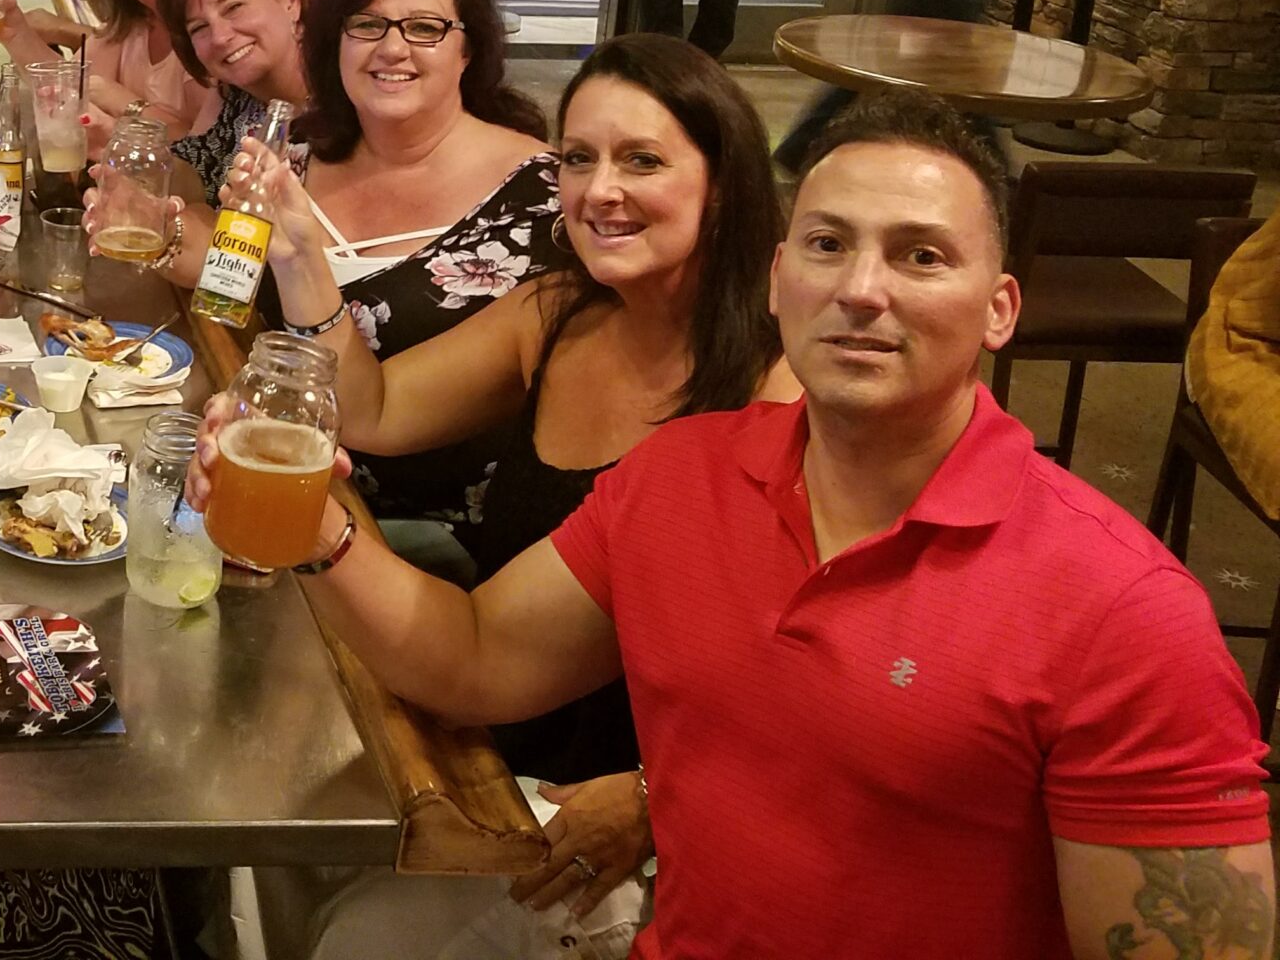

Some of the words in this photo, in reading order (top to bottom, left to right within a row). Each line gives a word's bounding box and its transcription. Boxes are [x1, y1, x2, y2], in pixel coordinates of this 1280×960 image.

[213, 230, 264, 263] Corona
[215, 251, 247, 272] Light
[14, 618, 52, 677] KEITH'S
[31, 616, 50, 648] GRILL
[45, 656, 65, 677] BAR
[39, 677, 70, 713] TOBY
